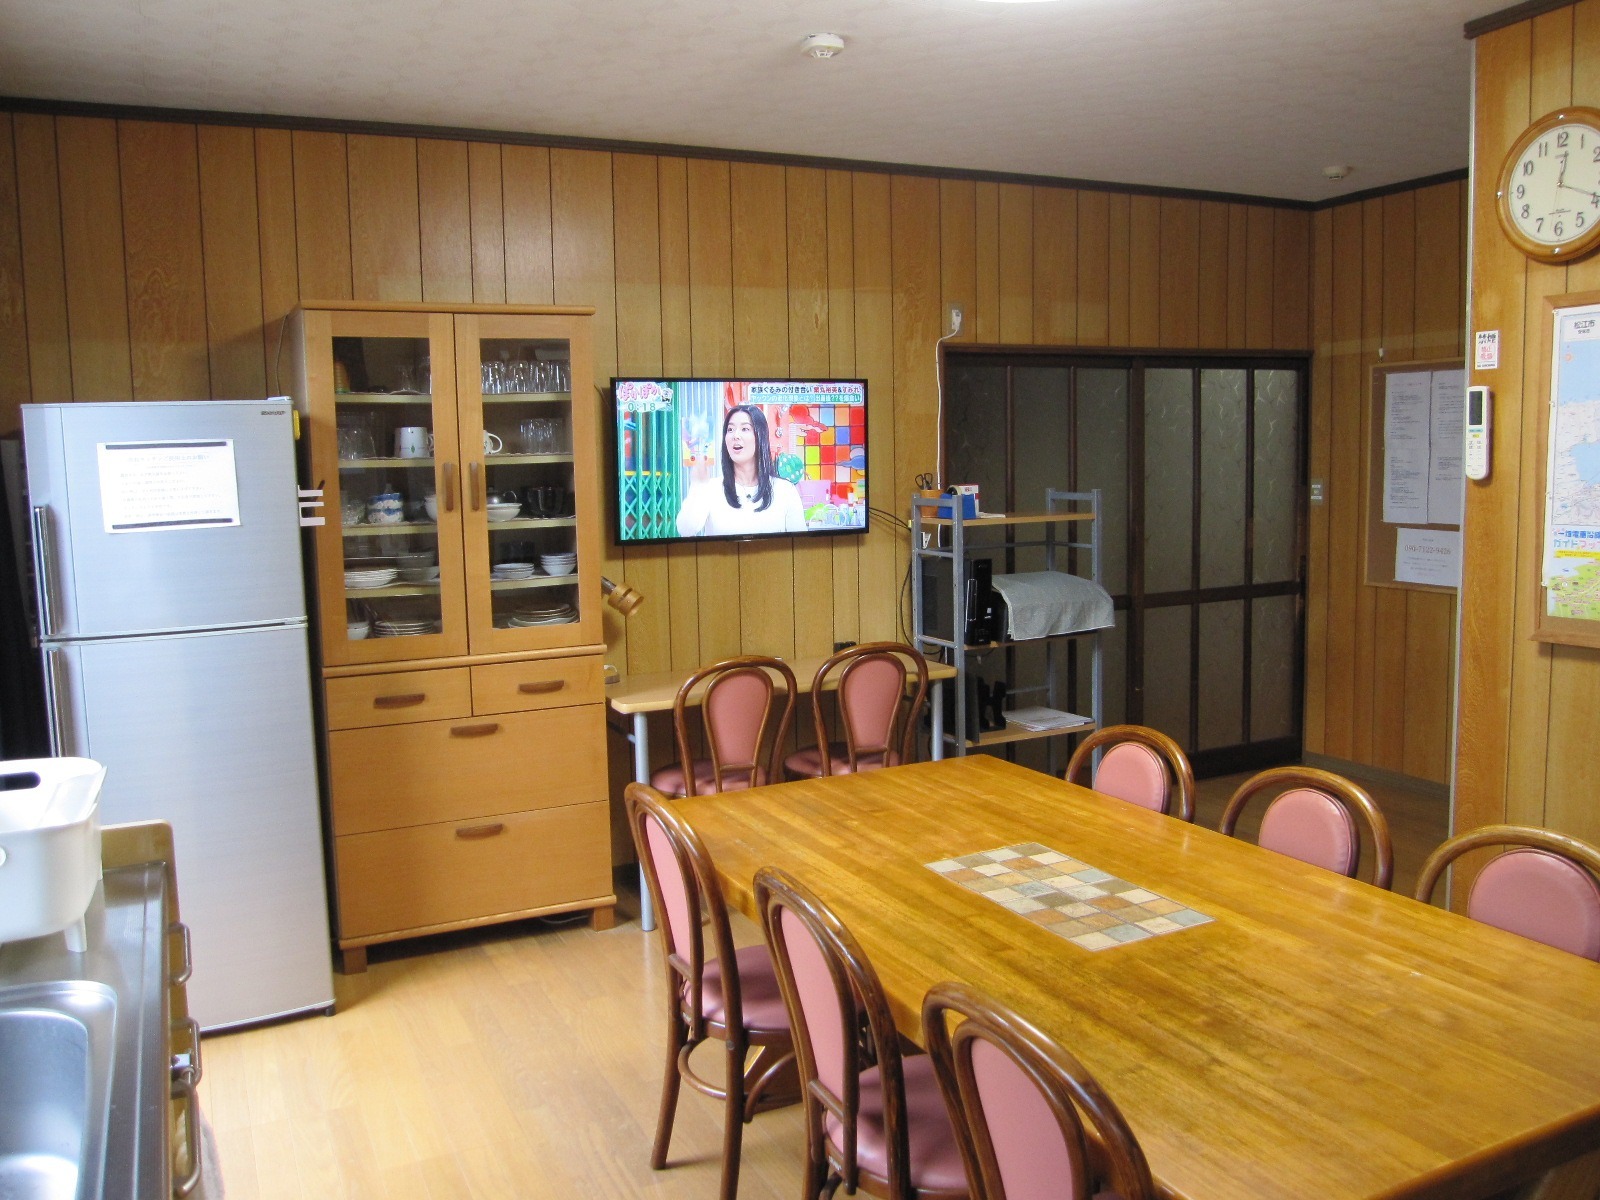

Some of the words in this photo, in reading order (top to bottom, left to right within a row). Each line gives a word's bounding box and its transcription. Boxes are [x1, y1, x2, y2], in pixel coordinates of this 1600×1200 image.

[1556, 131, 1569, 148] 12
[1581, 134, 1585, 149] 1
[1538, 141, 1549, 158] 11
[1593, 147, 1600, 163] 2
[1523, 160, 1534, 176] 10
[1516, 184, 1525, 200] 9
[1520, 203, 1530, 219] 8
[1535, 217, 1545, 233] 7
[1575, 211, 1584, 228] 5
[1554, 220, 1563, 237] 6
[628, 402, 656, 411] 0:18
